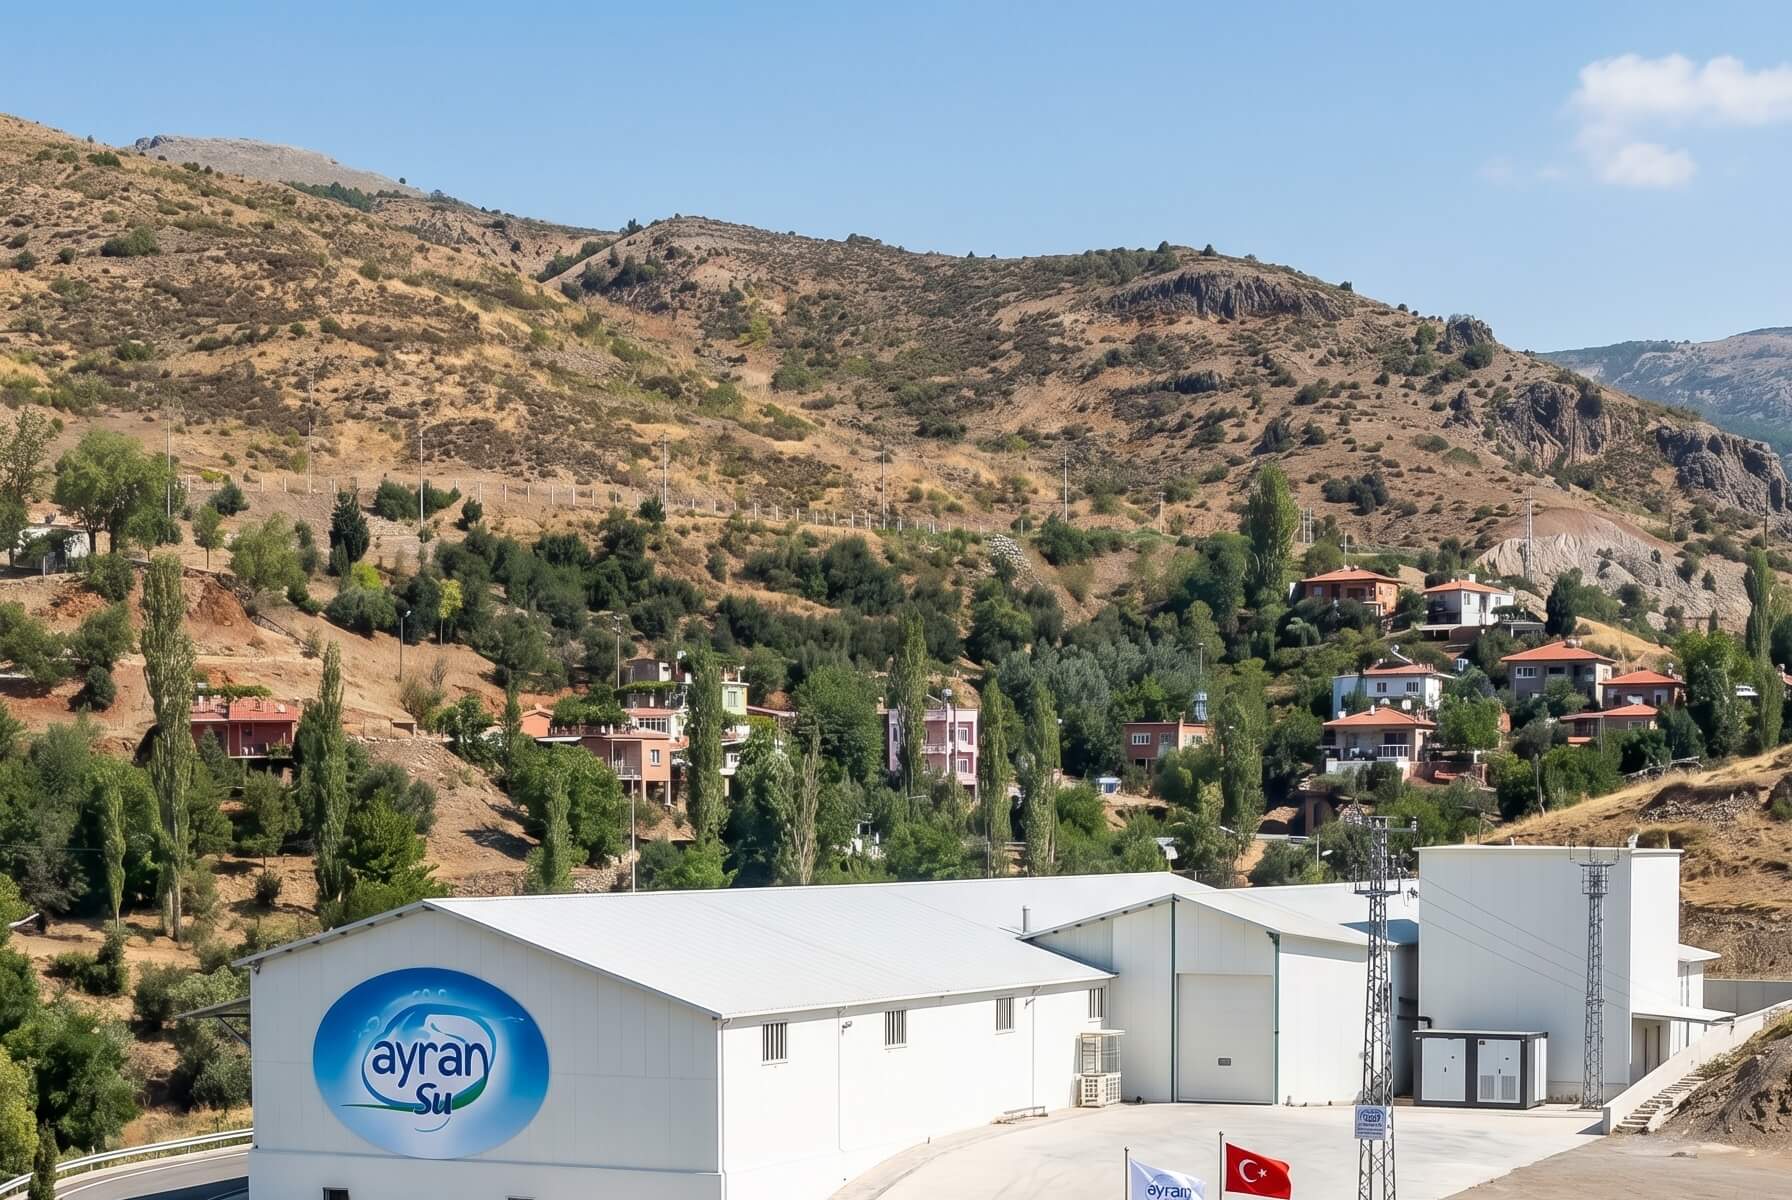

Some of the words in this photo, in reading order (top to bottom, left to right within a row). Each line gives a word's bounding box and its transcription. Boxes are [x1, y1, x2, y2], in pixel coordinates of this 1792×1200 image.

[372, 1041, 489, 1088] ayran
[414, 1083, 452, 1115] Su
[1147, 1184, 1192, 1200] ayran
